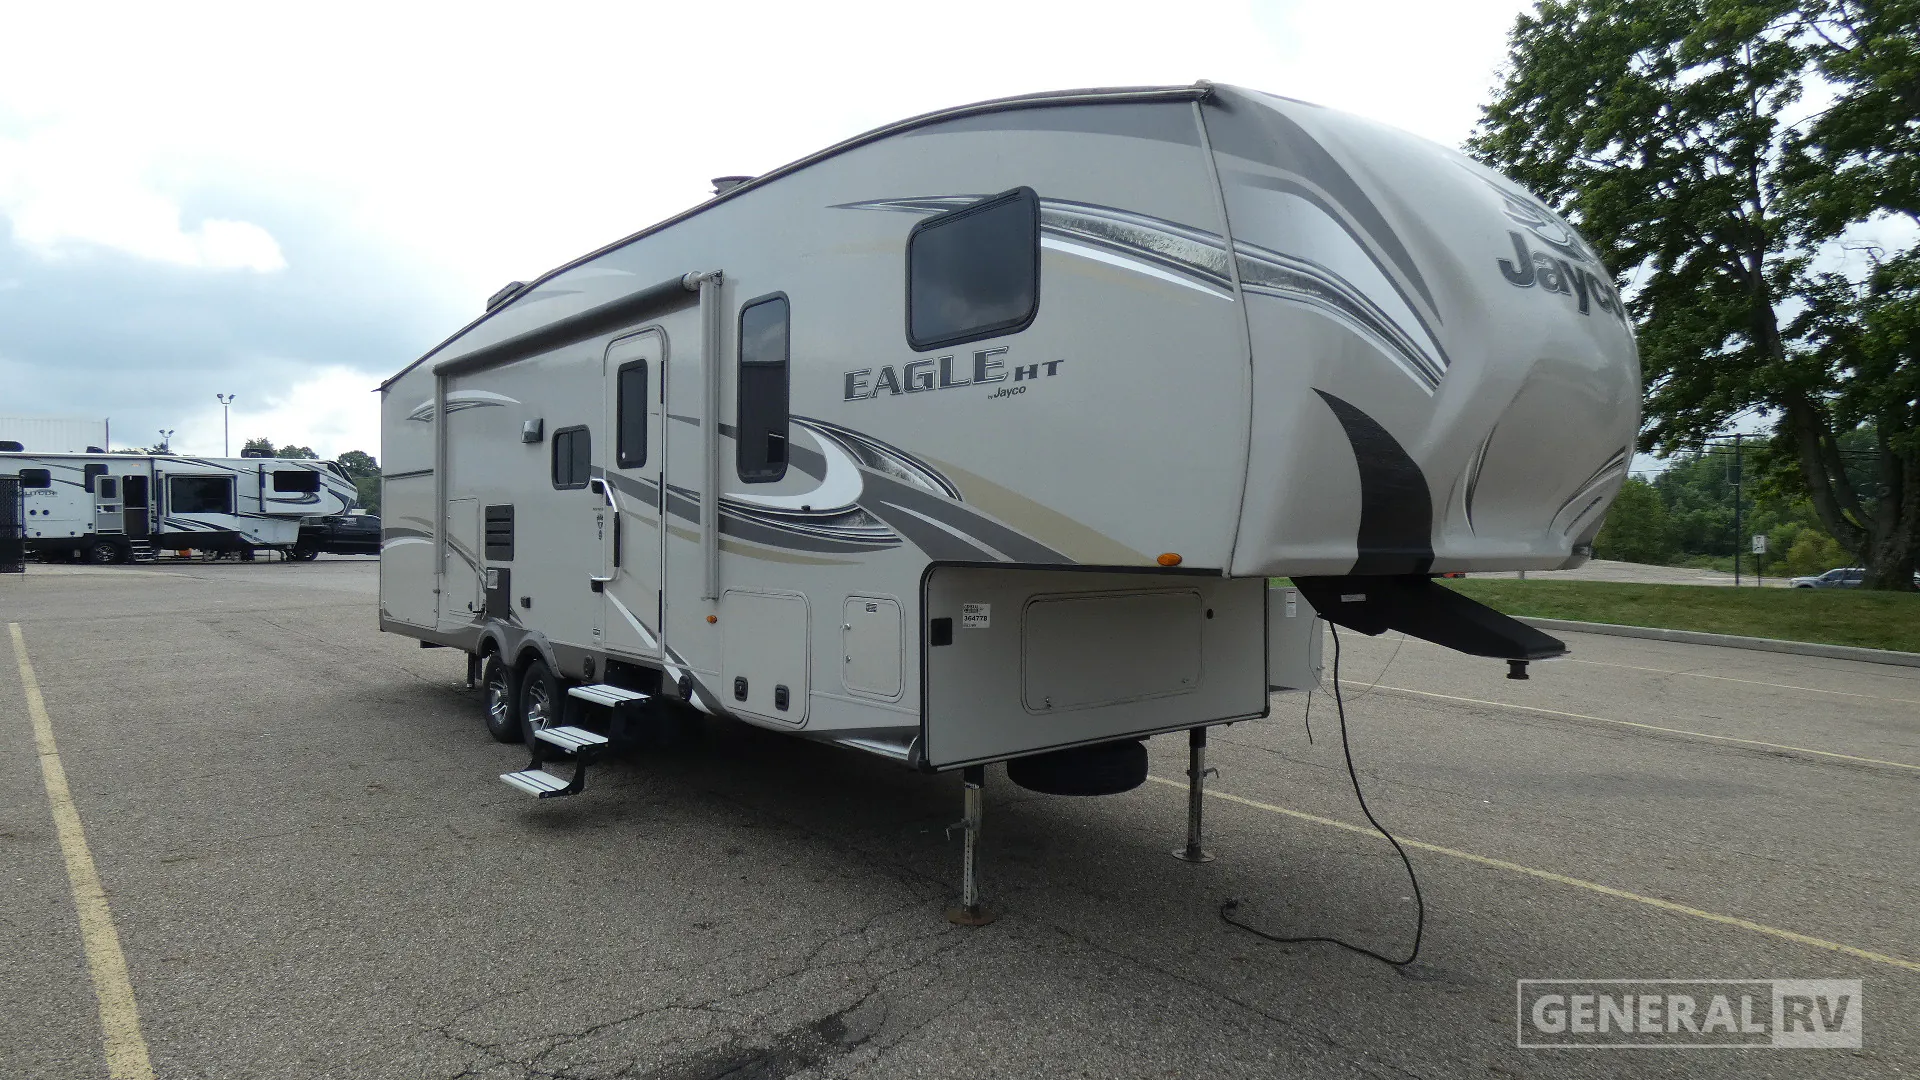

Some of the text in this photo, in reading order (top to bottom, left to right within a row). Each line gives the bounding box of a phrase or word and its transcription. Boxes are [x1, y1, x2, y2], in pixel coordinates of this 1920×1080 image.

[843, 345, 1065, 402] EAGLE HT
[993, 385, 1027, 399] Jayco
